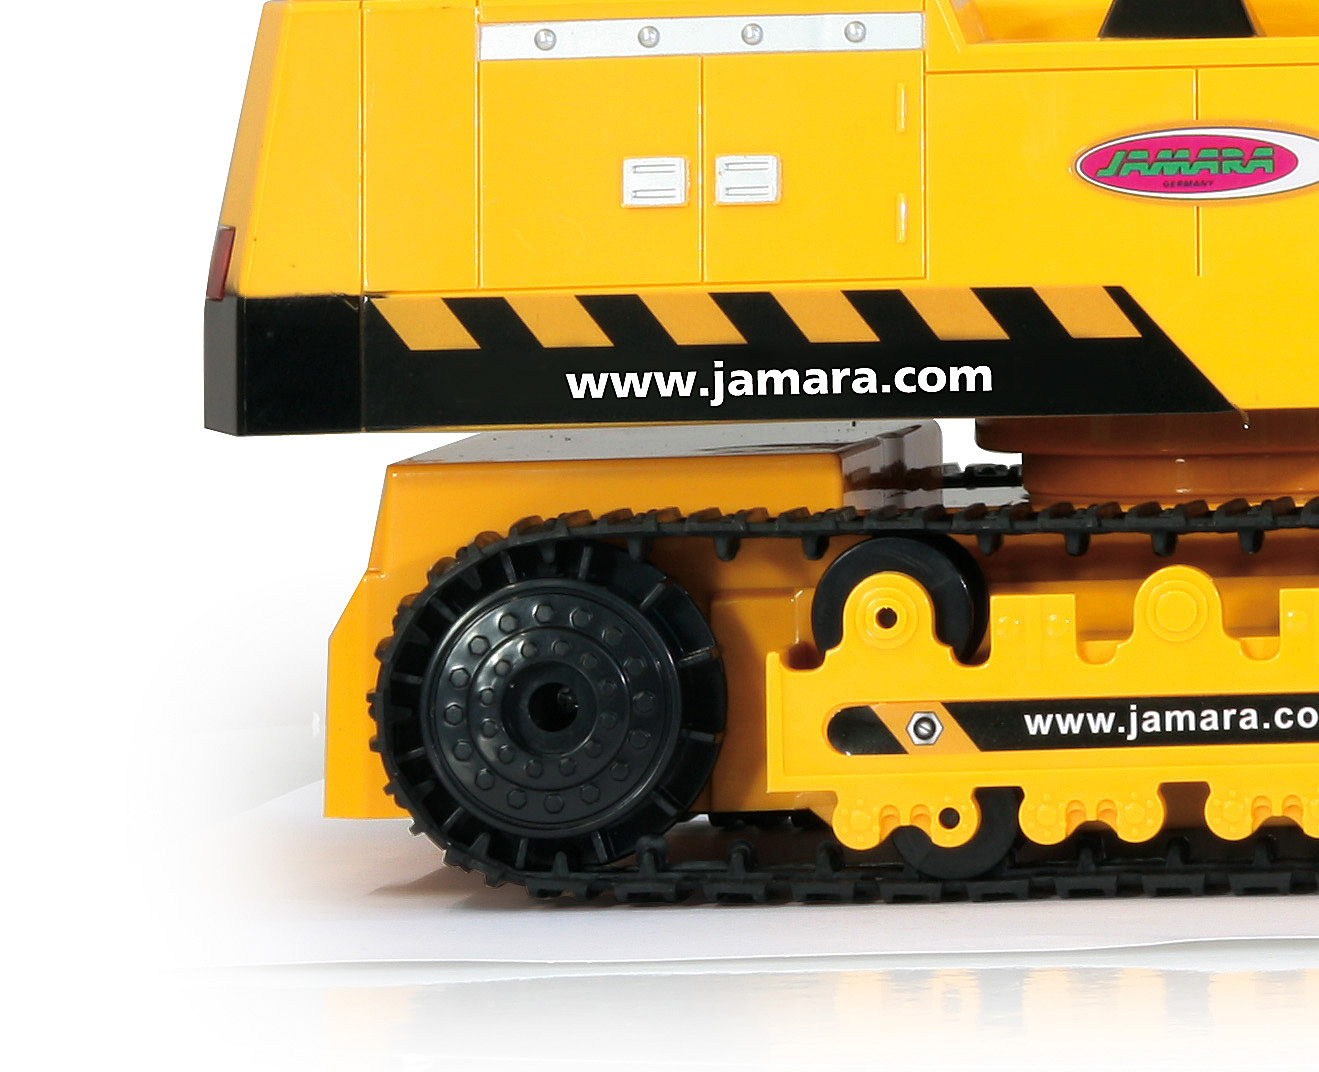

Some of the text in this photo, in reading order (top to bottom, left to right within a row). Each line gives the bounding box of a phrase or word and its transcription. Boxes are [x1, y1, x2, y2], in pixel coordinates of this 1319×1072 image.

[1096, 147, 1274, 177] JAMARA
[1162, 180, 1214, 188] GERMANY
[565, 360, 993, 407] www.jamara.com
